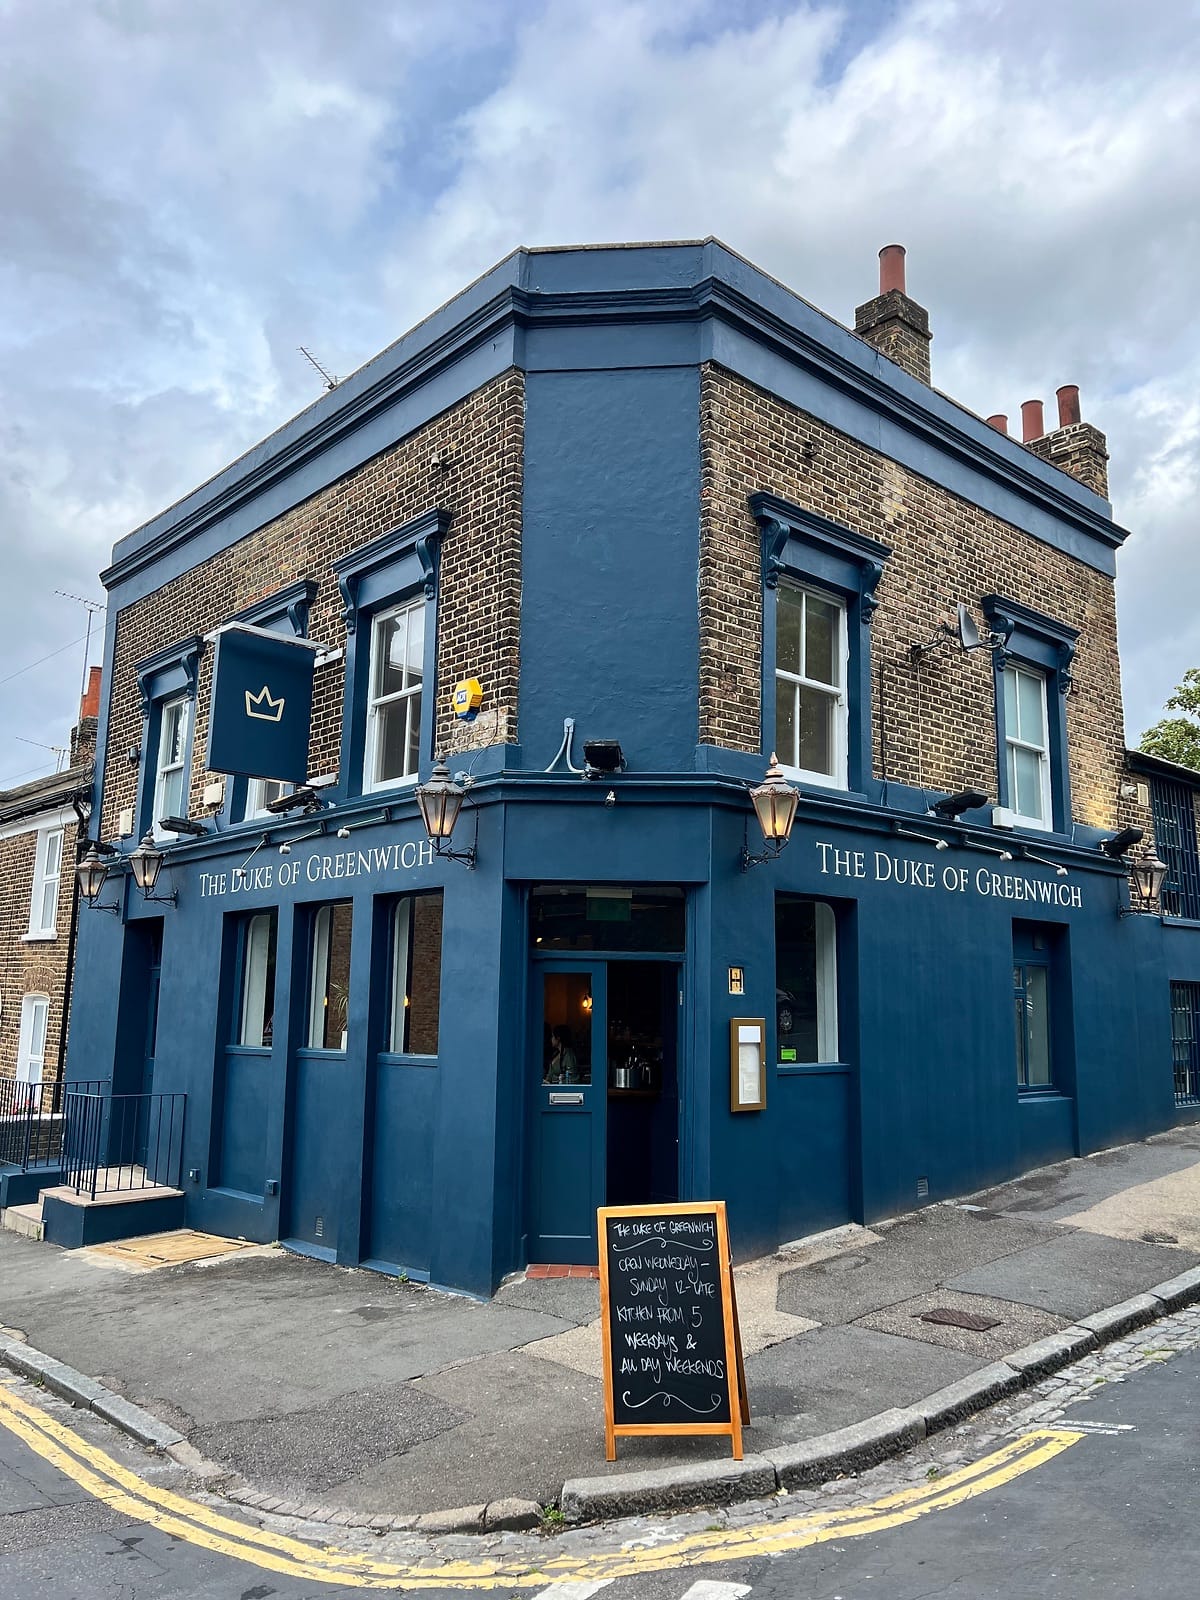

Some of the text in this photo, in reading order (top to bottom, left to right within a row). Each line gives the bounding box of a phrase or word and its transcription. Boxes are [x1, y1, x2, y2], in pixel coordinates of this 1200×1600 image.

[199, 839, 434, 897] THE DUKE OF GREENWICH
[815, 841, 1083, 907] THE DUKE OF GREENWICH
[613, 1220, 715, 1237] THE DUKE OF GREENWICH
[618, 1255, 642, 1272] OPEN
[629, 1277, 669, 1306] SUNDAY
[616, 1305, 703, 1328] KITCHEN FROM 5
[624, 1331, 698, 1360] WEEKDAYS &
[641, 1356, 662, 1384] DAY
[665, 1356, 724, 1379] WEEKENDS
